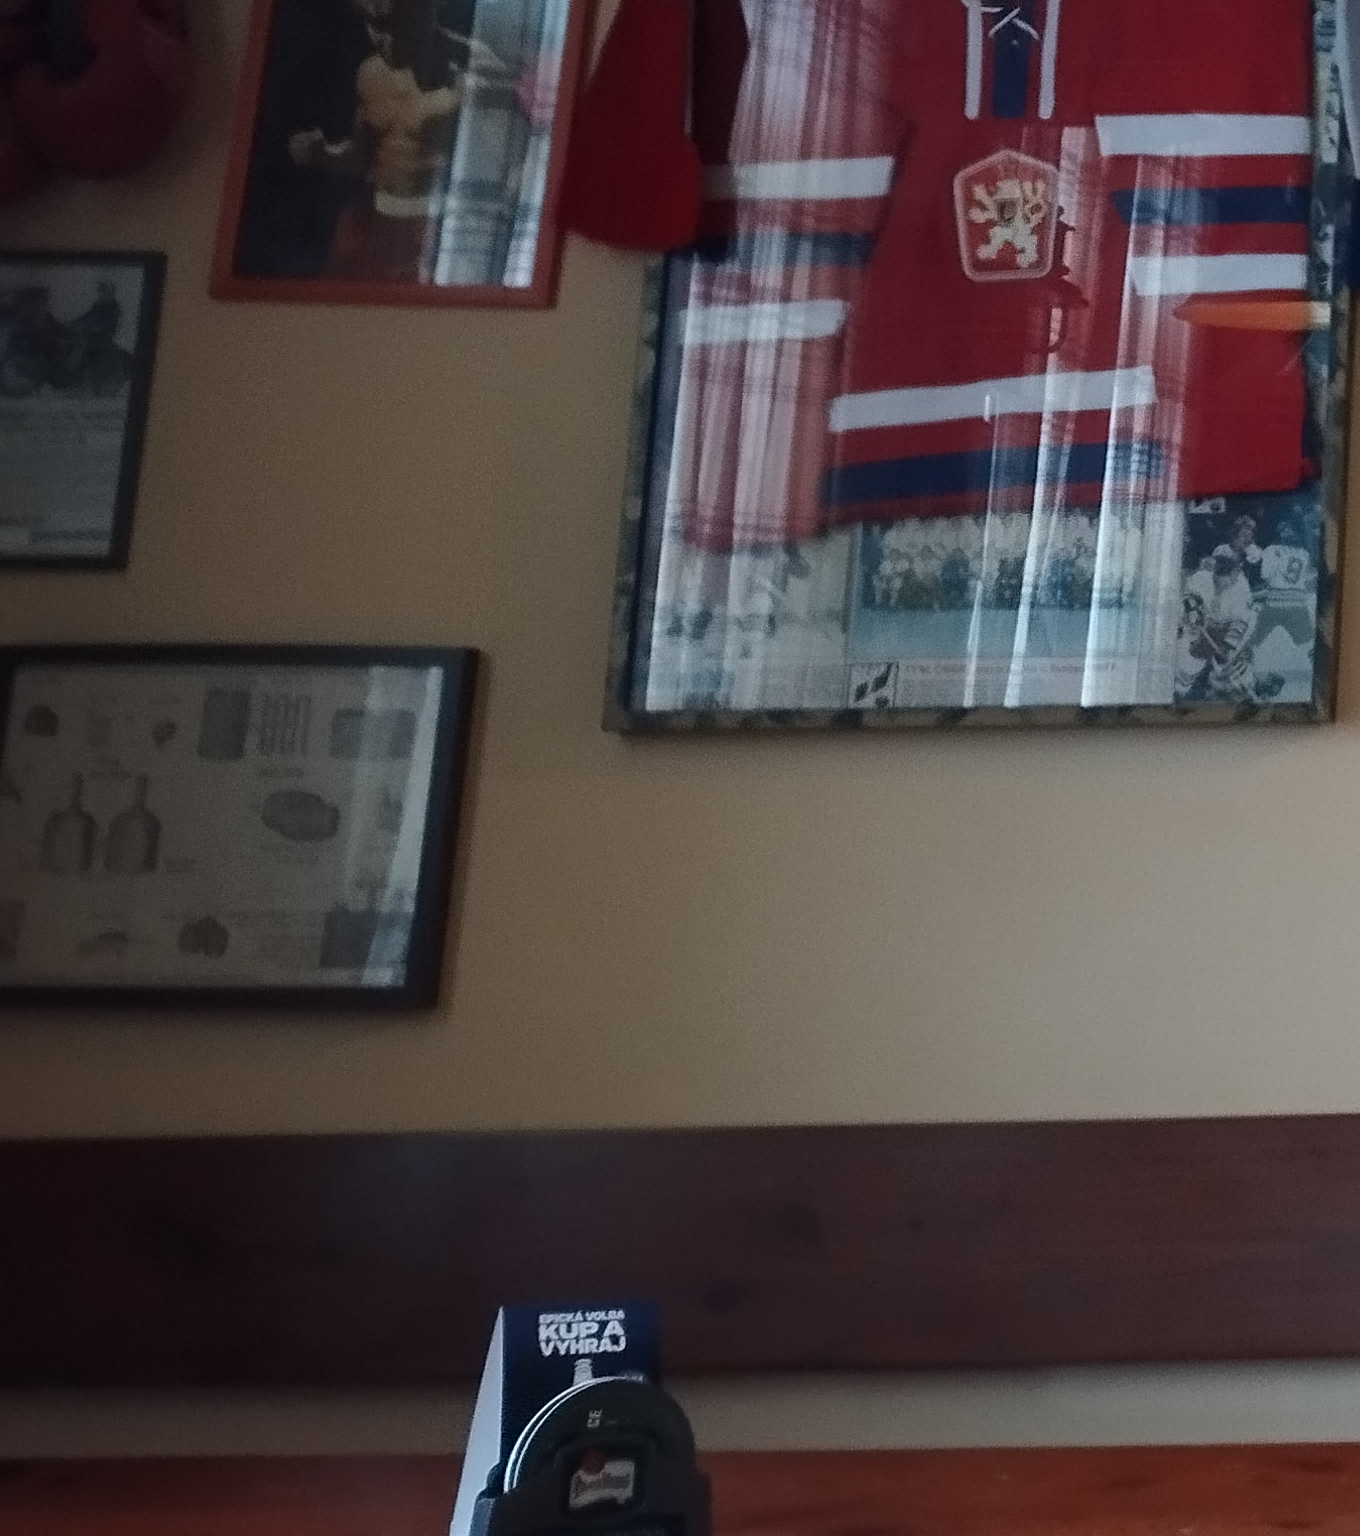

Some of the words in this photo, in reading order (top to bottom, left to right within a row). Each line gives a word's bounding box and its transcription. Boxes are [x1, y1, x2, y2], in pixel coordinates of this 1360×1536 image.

[538, 1321, 600, 1342] KUP
[602, 1320, 626, 1337] A
[539, 1335, 627, 1358] VYHRAJ
